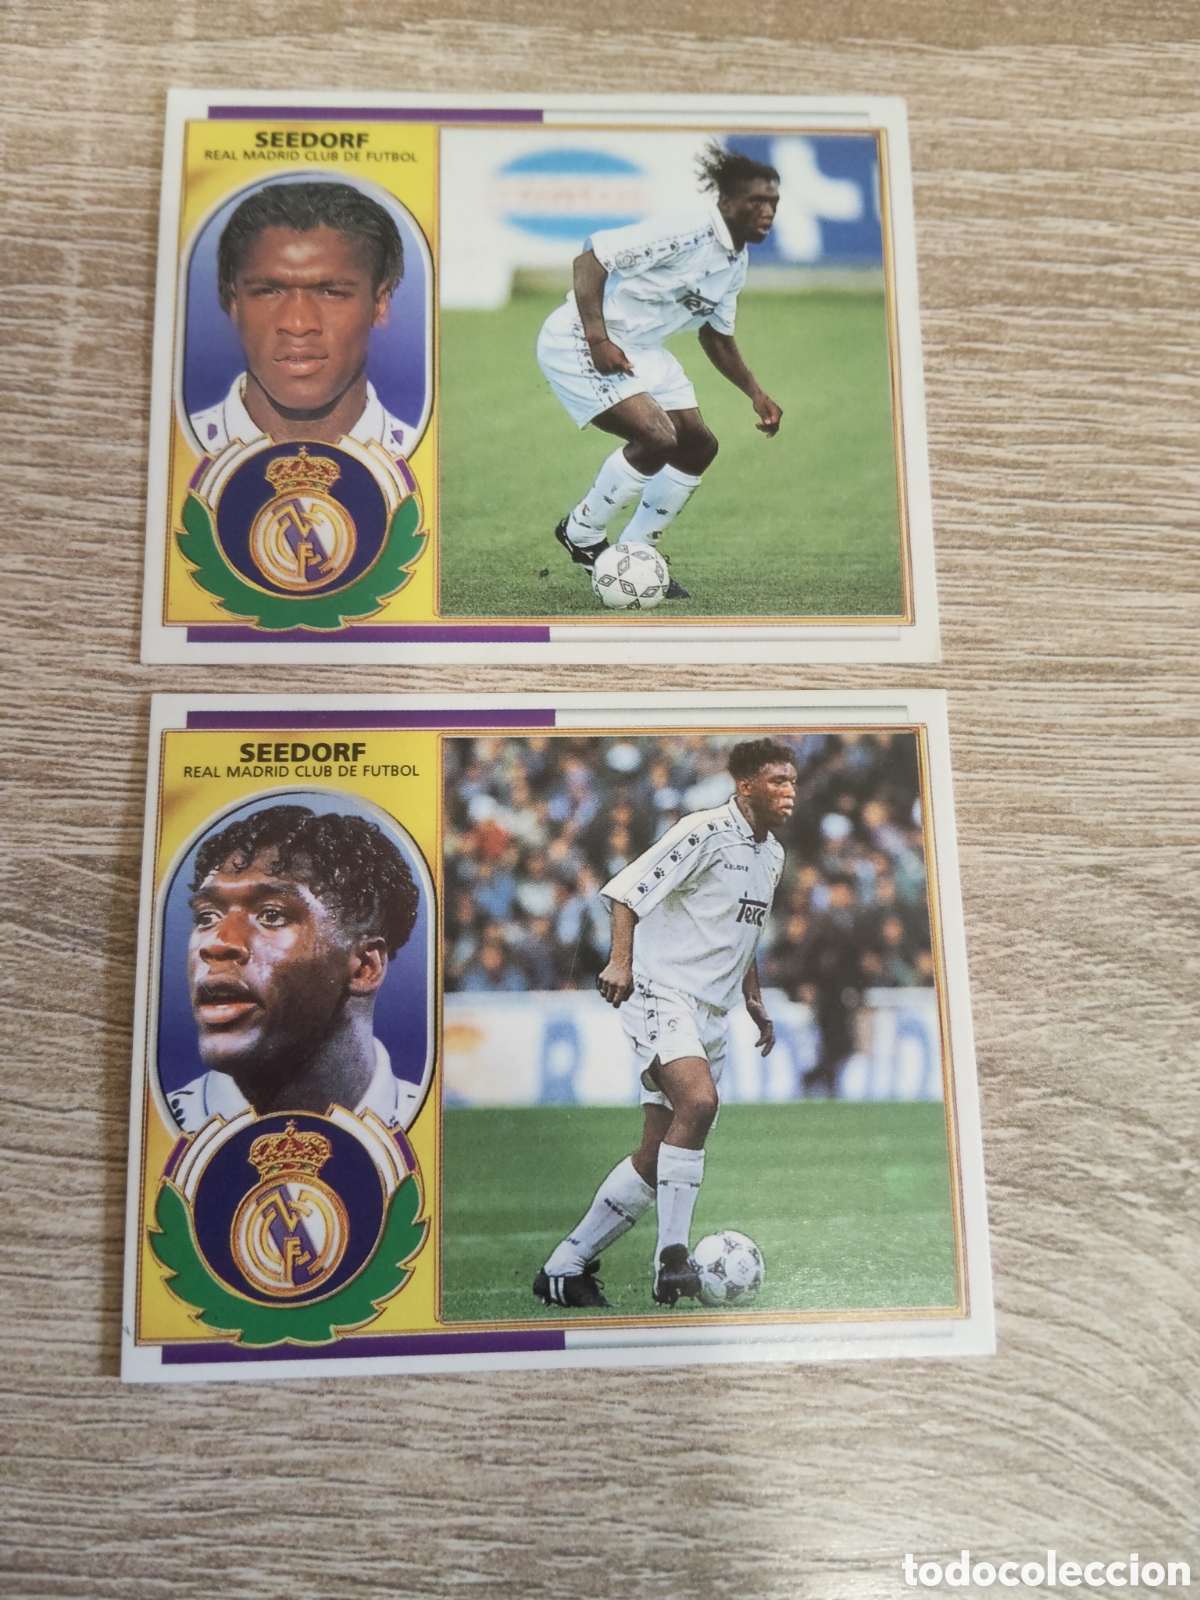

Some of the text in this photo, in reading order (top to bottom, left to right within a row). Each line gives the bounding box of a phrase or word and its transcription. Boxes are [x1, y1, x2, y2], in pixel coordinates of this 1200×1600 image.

[255, 131, 370, 149] SEEDORF
[204, 149, 418, 163] REAL MADRID CLUB DE FUTBOL
[239, 742, 367, 763] SEEDORF
[183, 764, 420, 778] REAL MADRID CLUB DE FUTBOL
